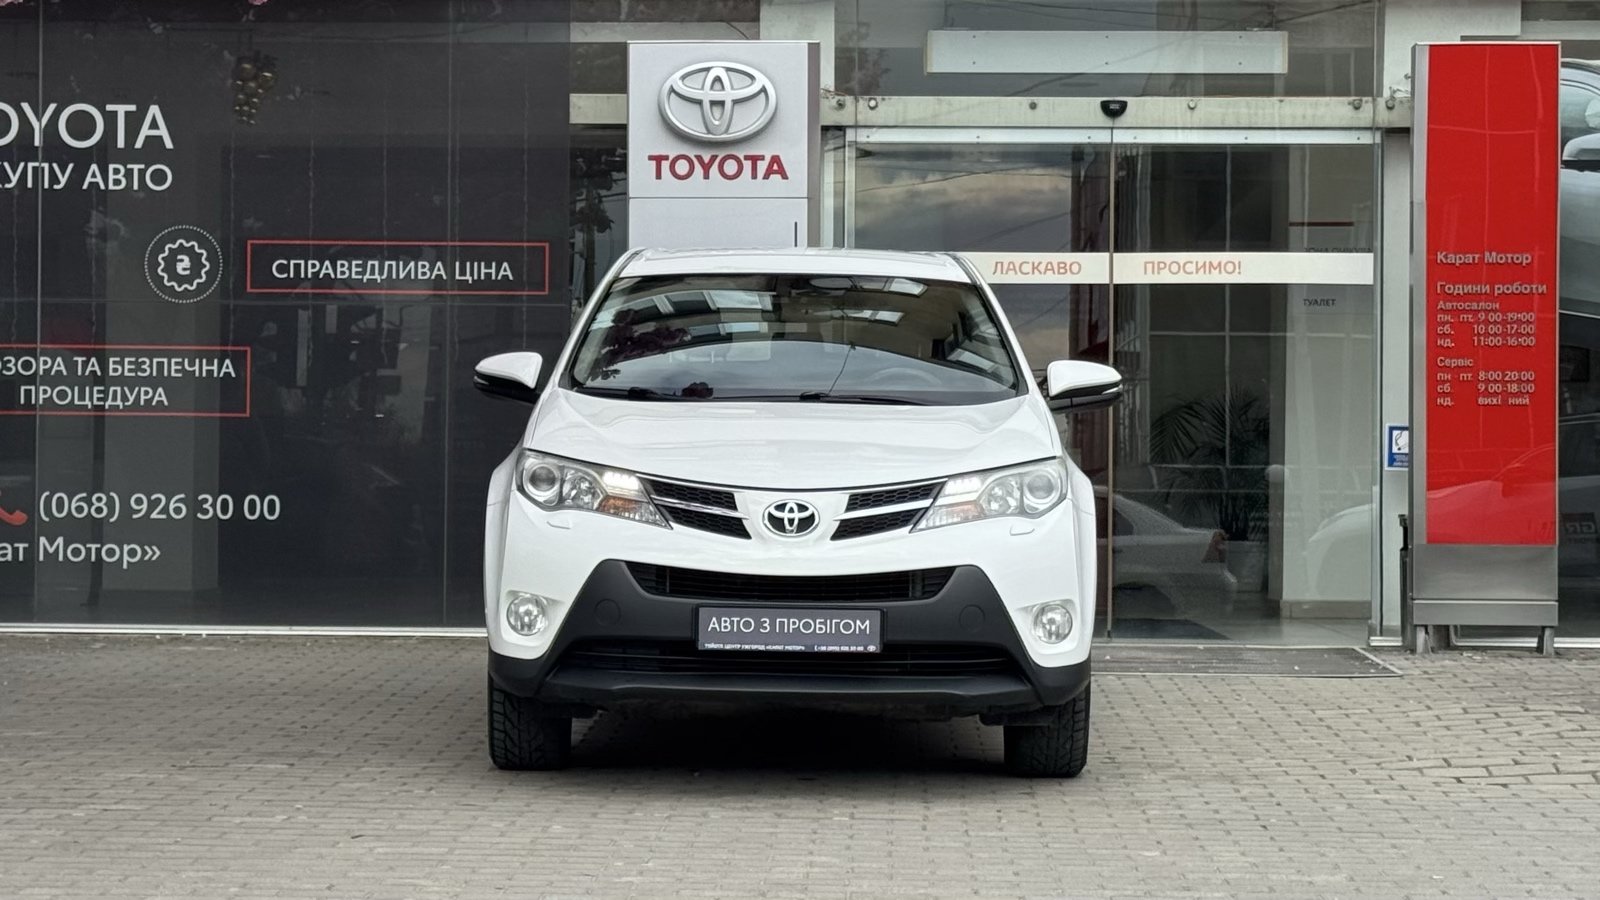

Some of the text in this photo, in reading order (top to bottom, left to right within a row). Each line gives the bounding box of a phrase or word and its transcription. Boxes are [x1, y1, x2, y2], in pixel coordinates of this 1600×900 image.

[648, 154, 789, 181] TOYOTA
[0, 162, 173, 191] УПУ АВТО
[1437, 251, 1532, 266] Карат Мотор
[271, 259, 514, 284] СПРАВЕДЛИВА ЦІНА
[992, 260, 1242, 276] ЛАСКАВО ПРОСИМО!
[1437, 282, 1547, 296] Години роботи
[1303, 298, 1336, 307] ТУАЛЕТ
[1437, 301, 1500, 311] Автосалон
[1437, 324, 1455, 335] сб.
[1437, 338, 1456, 348] нд.
[0, 356, 236, 377] ЗОРА ТА БЕЗПЕЧНА
[1437, 357, 1474, 368] Сервіс
[20, 386, 169, 409] ПРОЦЕДУРА
[39, 491, 281, 522] (068) 926 30 00
[38, 536, 161, 569] Мотор»
[707, 617, 755, 633] АВТО
[776, 618, 870, 634] ПРОБІГОМ
